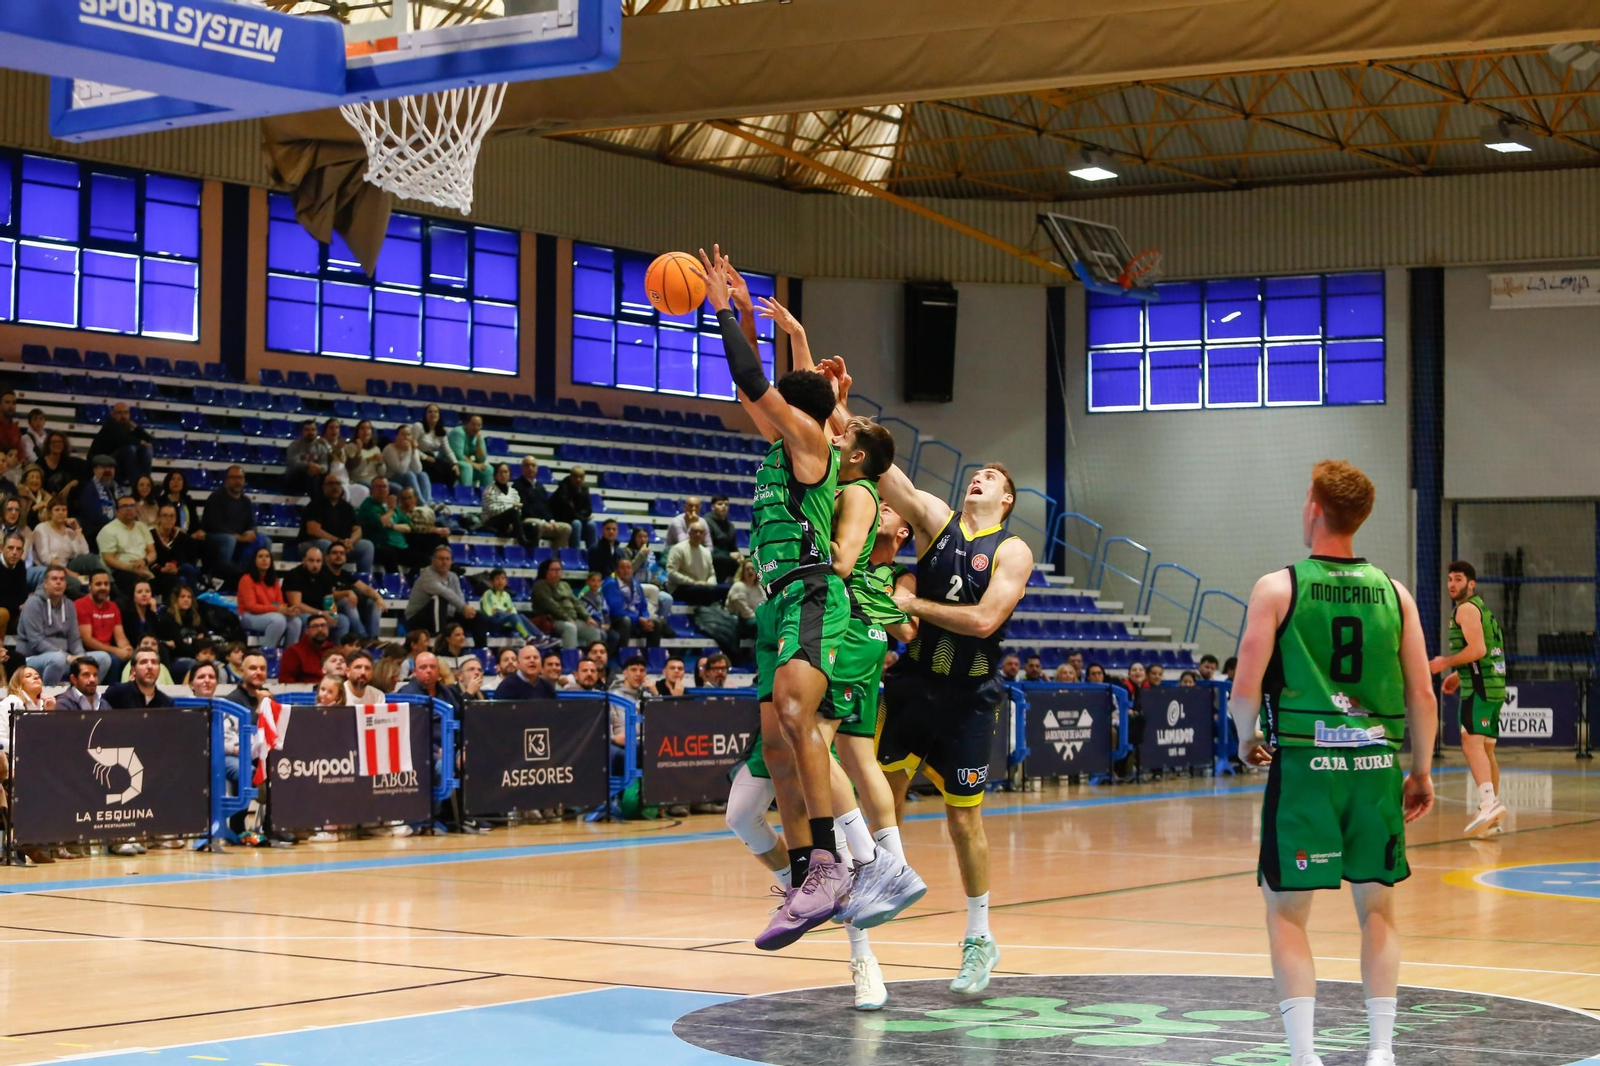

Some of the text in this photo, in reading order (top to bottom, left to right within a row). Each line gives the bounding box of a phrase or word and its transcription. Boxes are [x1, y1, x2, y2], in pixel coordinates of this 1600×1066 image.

[79, 0, 283, 53] SPORT SYSTEM
[945, 574, 963, 602] 2
[1311, 583, 1385, 604] MONCANUT
[1330, 616, 1363, 684] 8
[1157, 728, 1194, 745] LLAMADOR
[293, 750, 355, 783] surpool
[1310, 757, 1349, 771] CAJA
[373, 770, 419, 788] LABOR
[502, 766, 574, 787] ASESORES
[76, 808, 154, 822] LA ESQUINA
